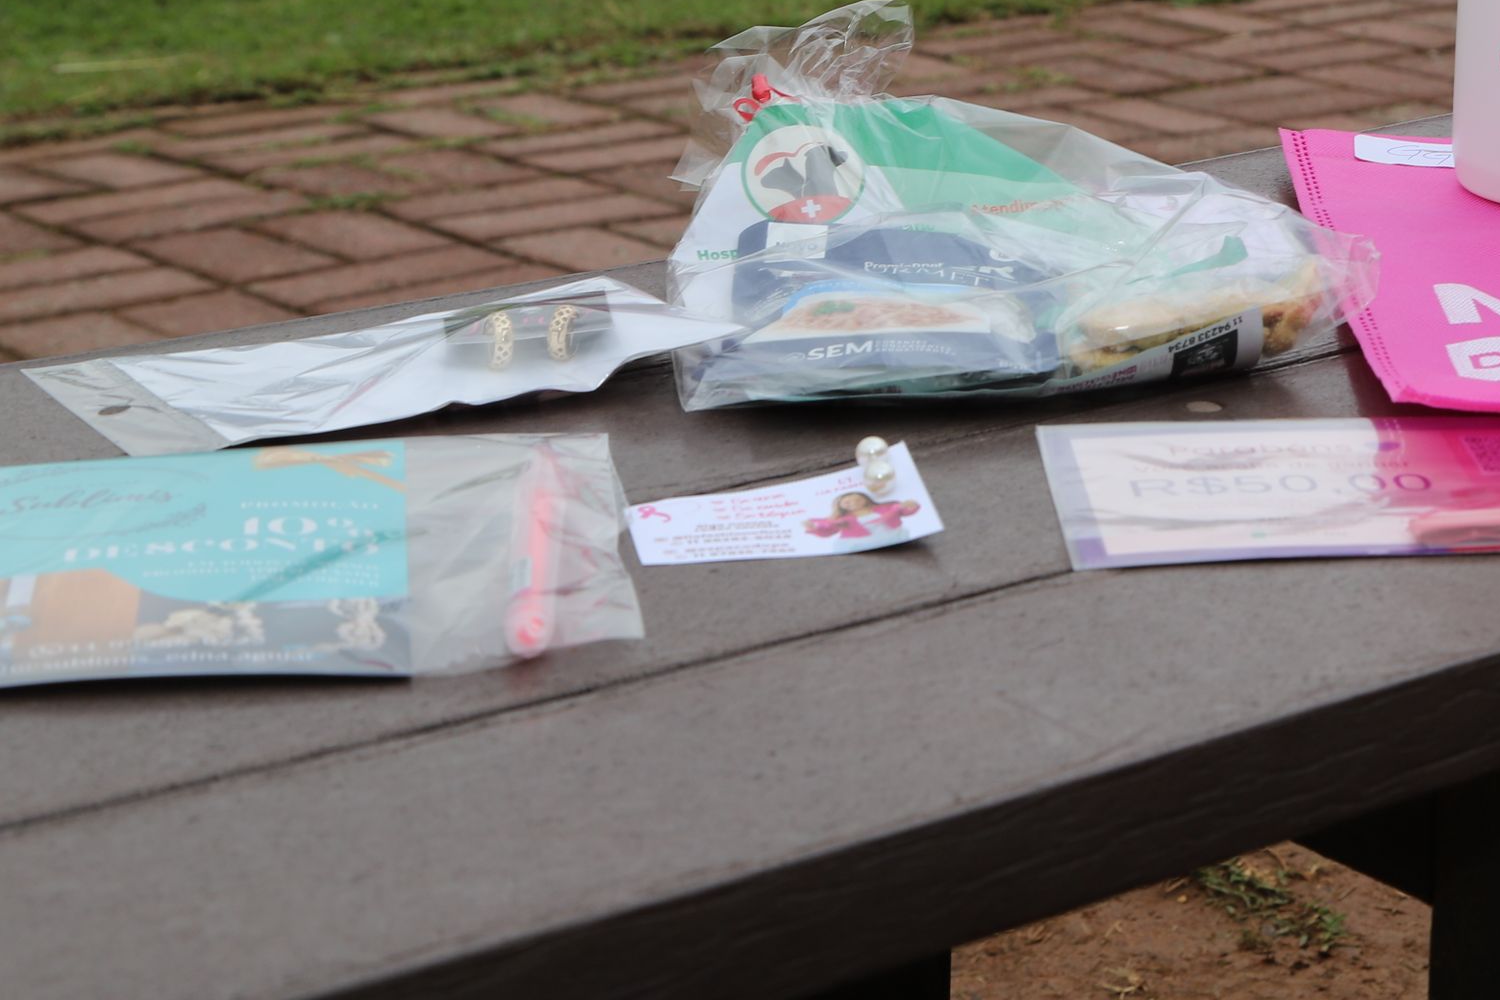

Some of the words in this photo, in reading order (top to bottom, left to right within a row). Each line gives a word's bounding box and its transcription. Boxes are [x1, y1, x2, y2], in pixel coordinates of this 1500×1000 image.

[1197, 322, 1232, 343] 94233
[806, 339, 874, 362] SEM
[1167, 336, 1197, 354] 8734
